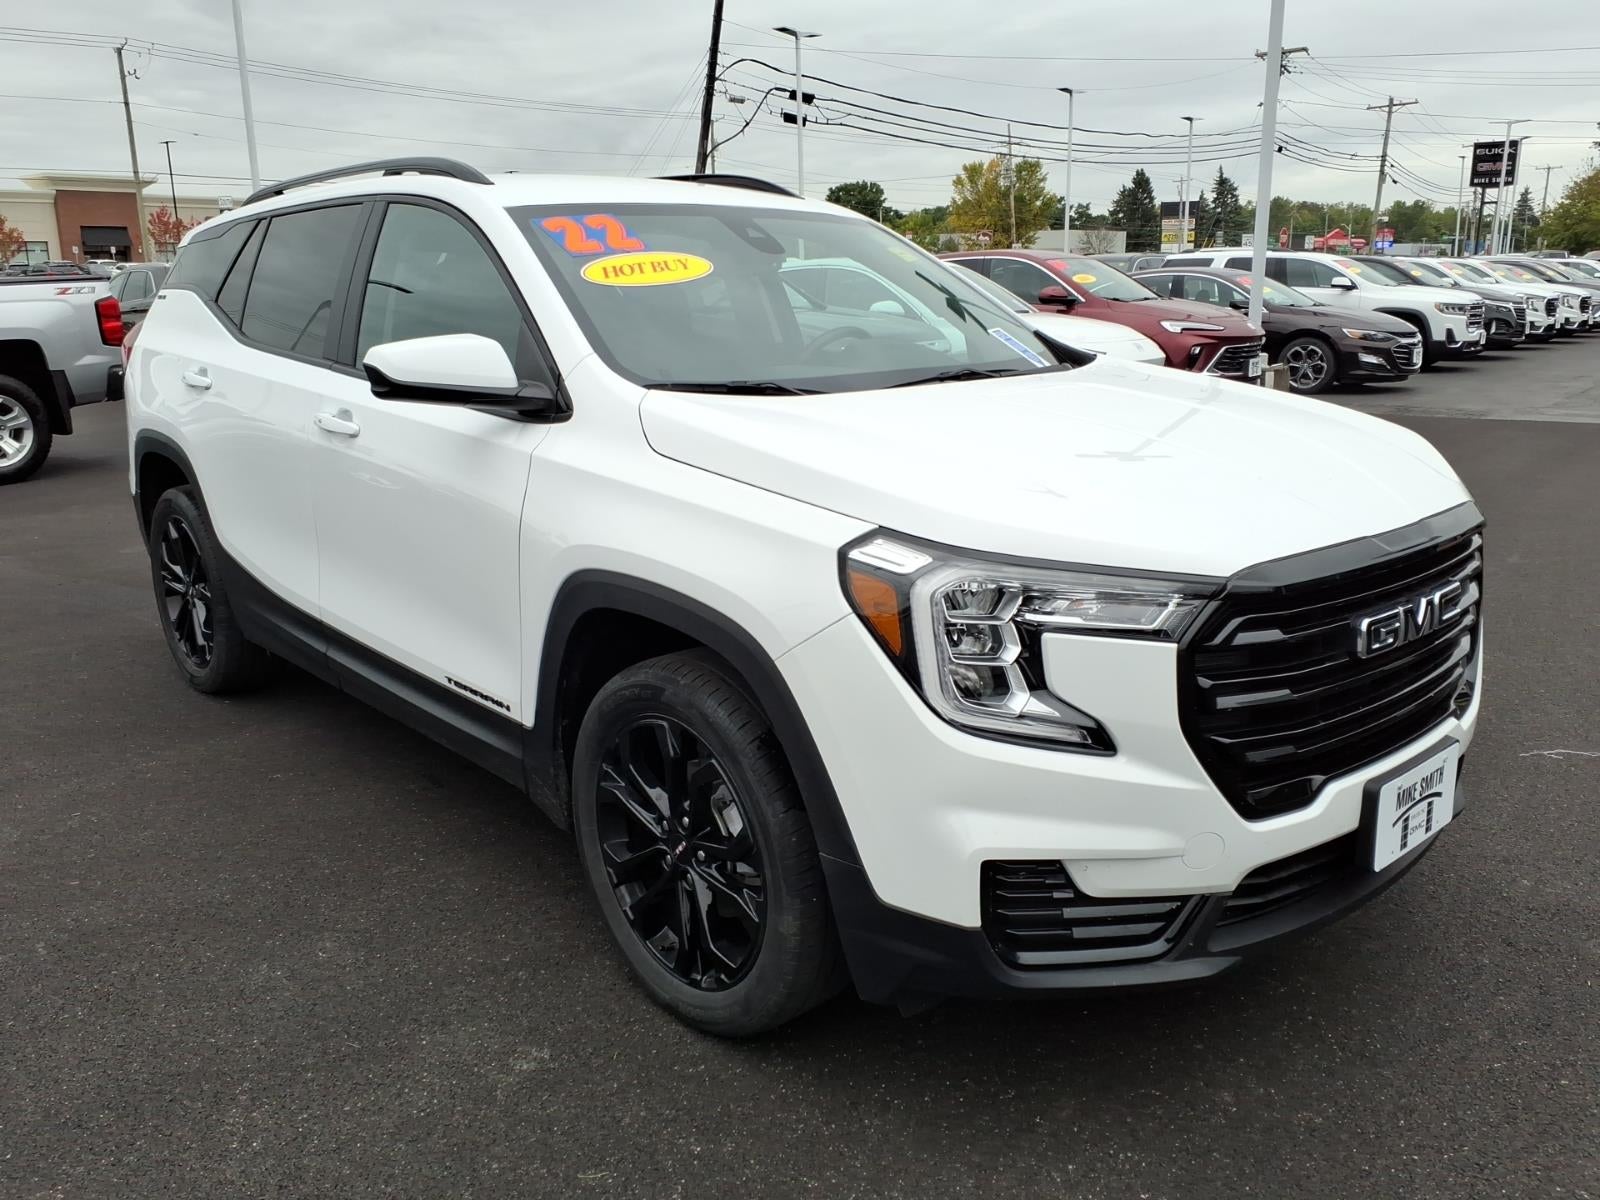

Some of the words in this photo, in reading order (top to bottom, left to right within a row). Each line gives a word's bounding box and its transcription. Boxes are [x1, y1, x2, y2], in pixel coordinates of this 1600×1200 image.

[541, 213, 645, 254] 22
[602, 262, 647, 280] HOT
[652, 257, 689, 273] BUY
[1357, 581, 1463, 659] GMC
[1396, 782, 1419, 811] MIKE
[1420, 765, 1445, 797] SMITH
